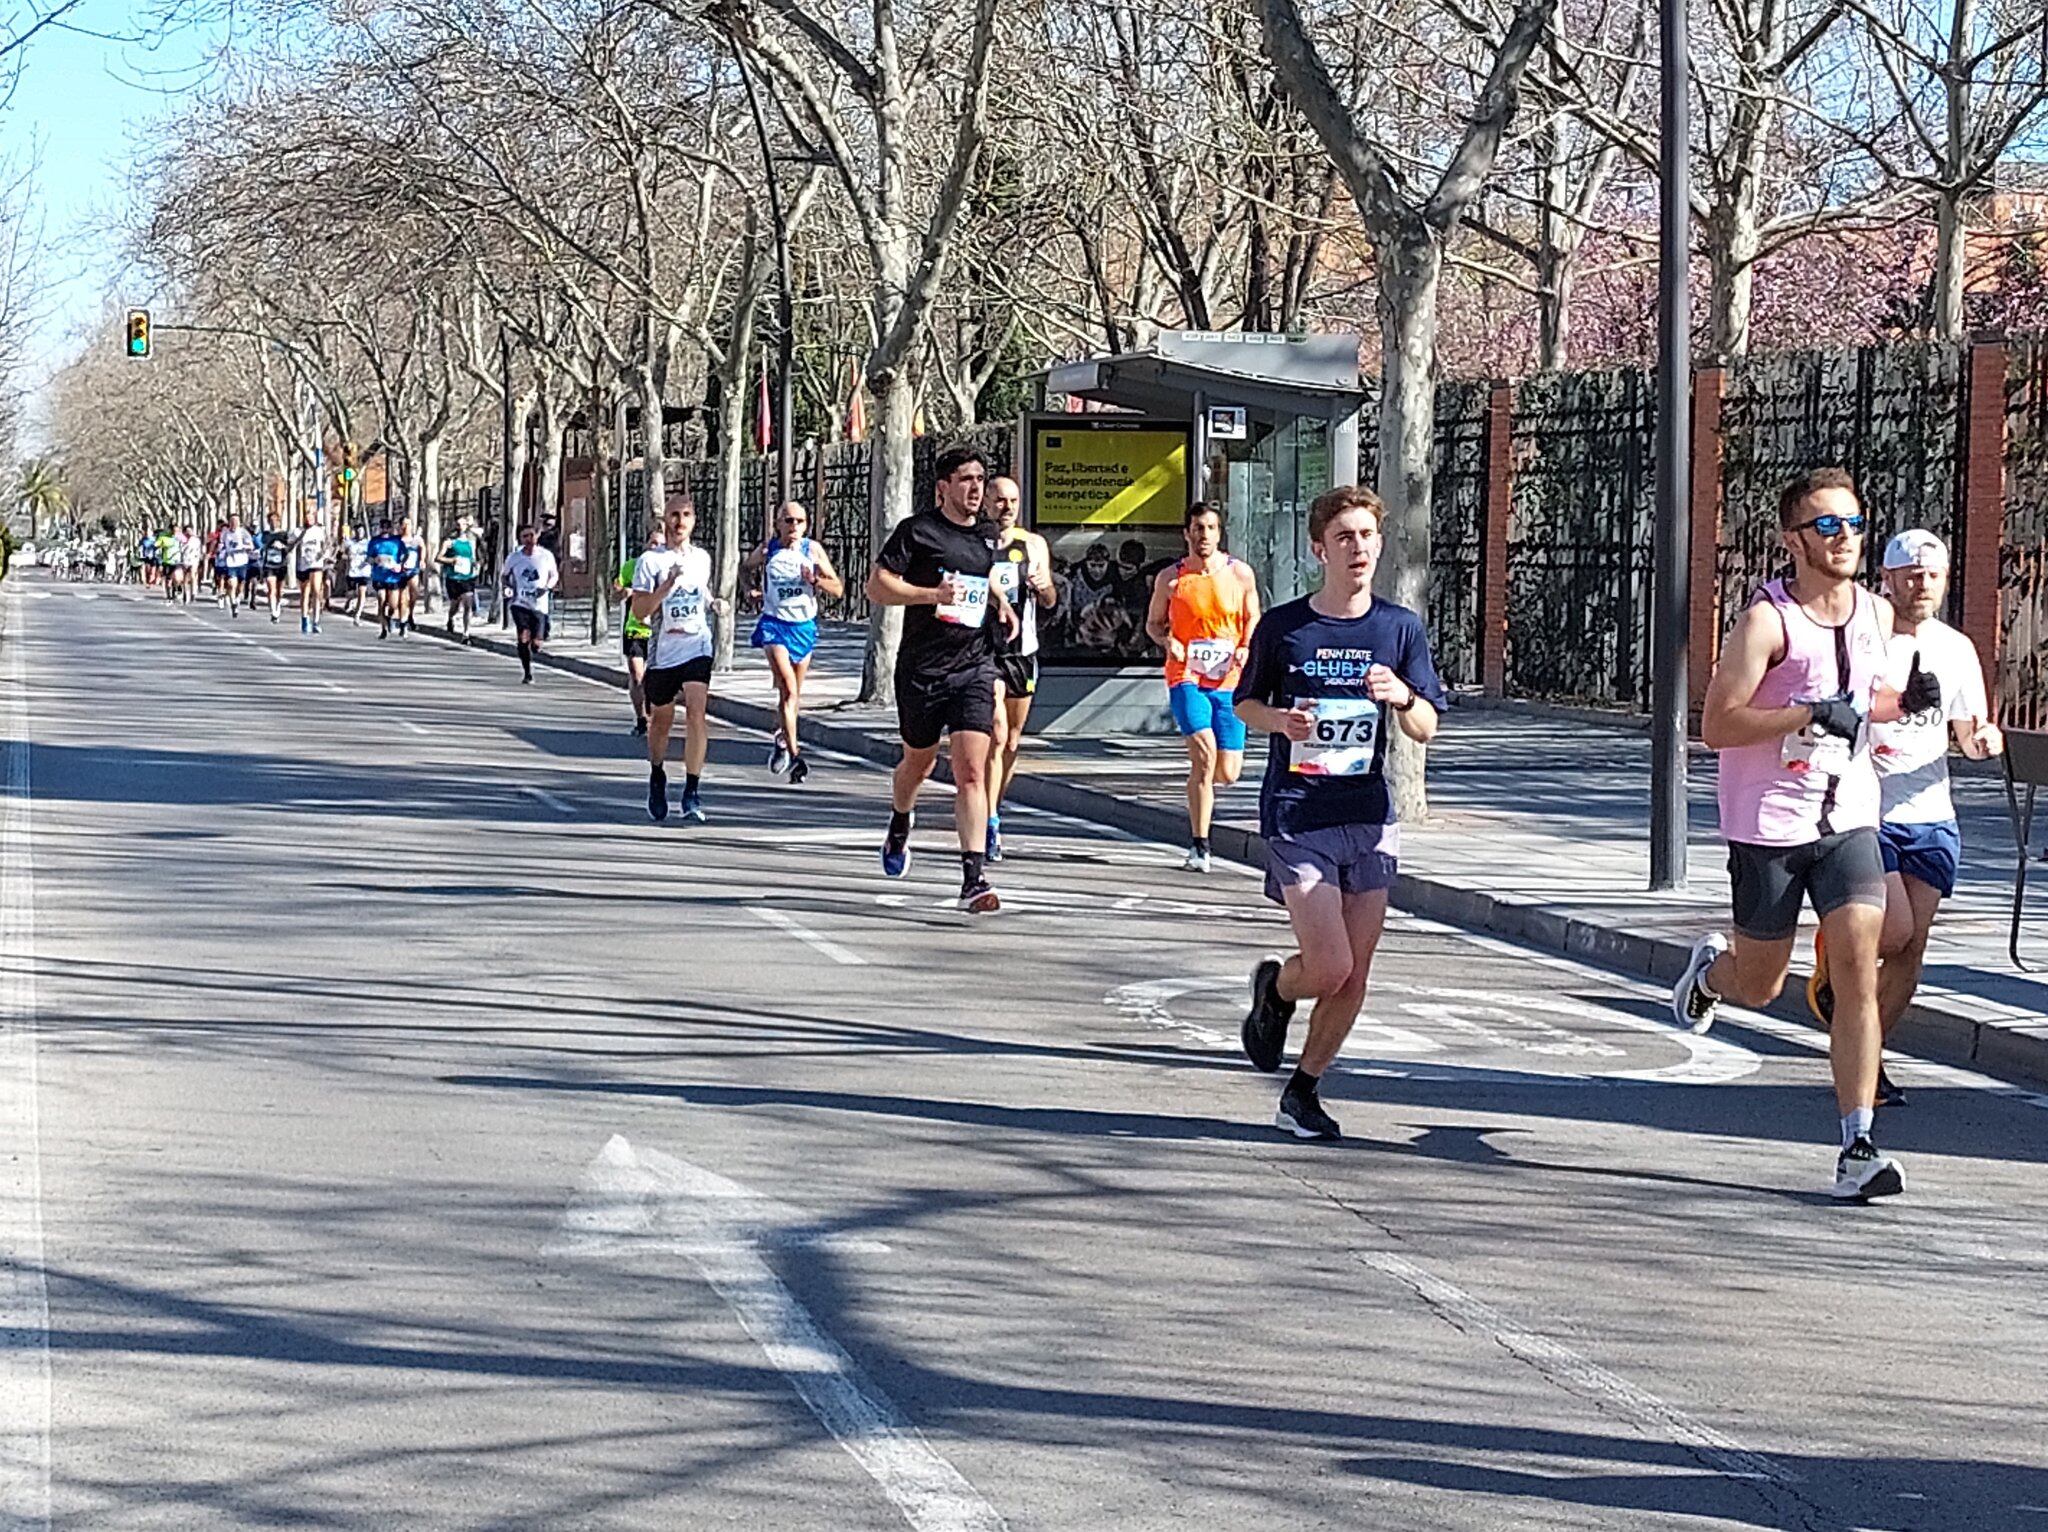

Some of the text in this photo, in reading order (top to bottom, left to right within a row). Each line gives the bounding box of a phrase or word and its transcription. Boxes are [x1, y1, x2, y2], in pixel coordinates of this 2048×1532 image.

[1045, 462, 1129, 474] Paz, libertad e
[1316, 648, 1373, 661] PENN STATE
[1303, 660, 1354, 677] CLUB
[1317, 720, 1373, 742] 673
